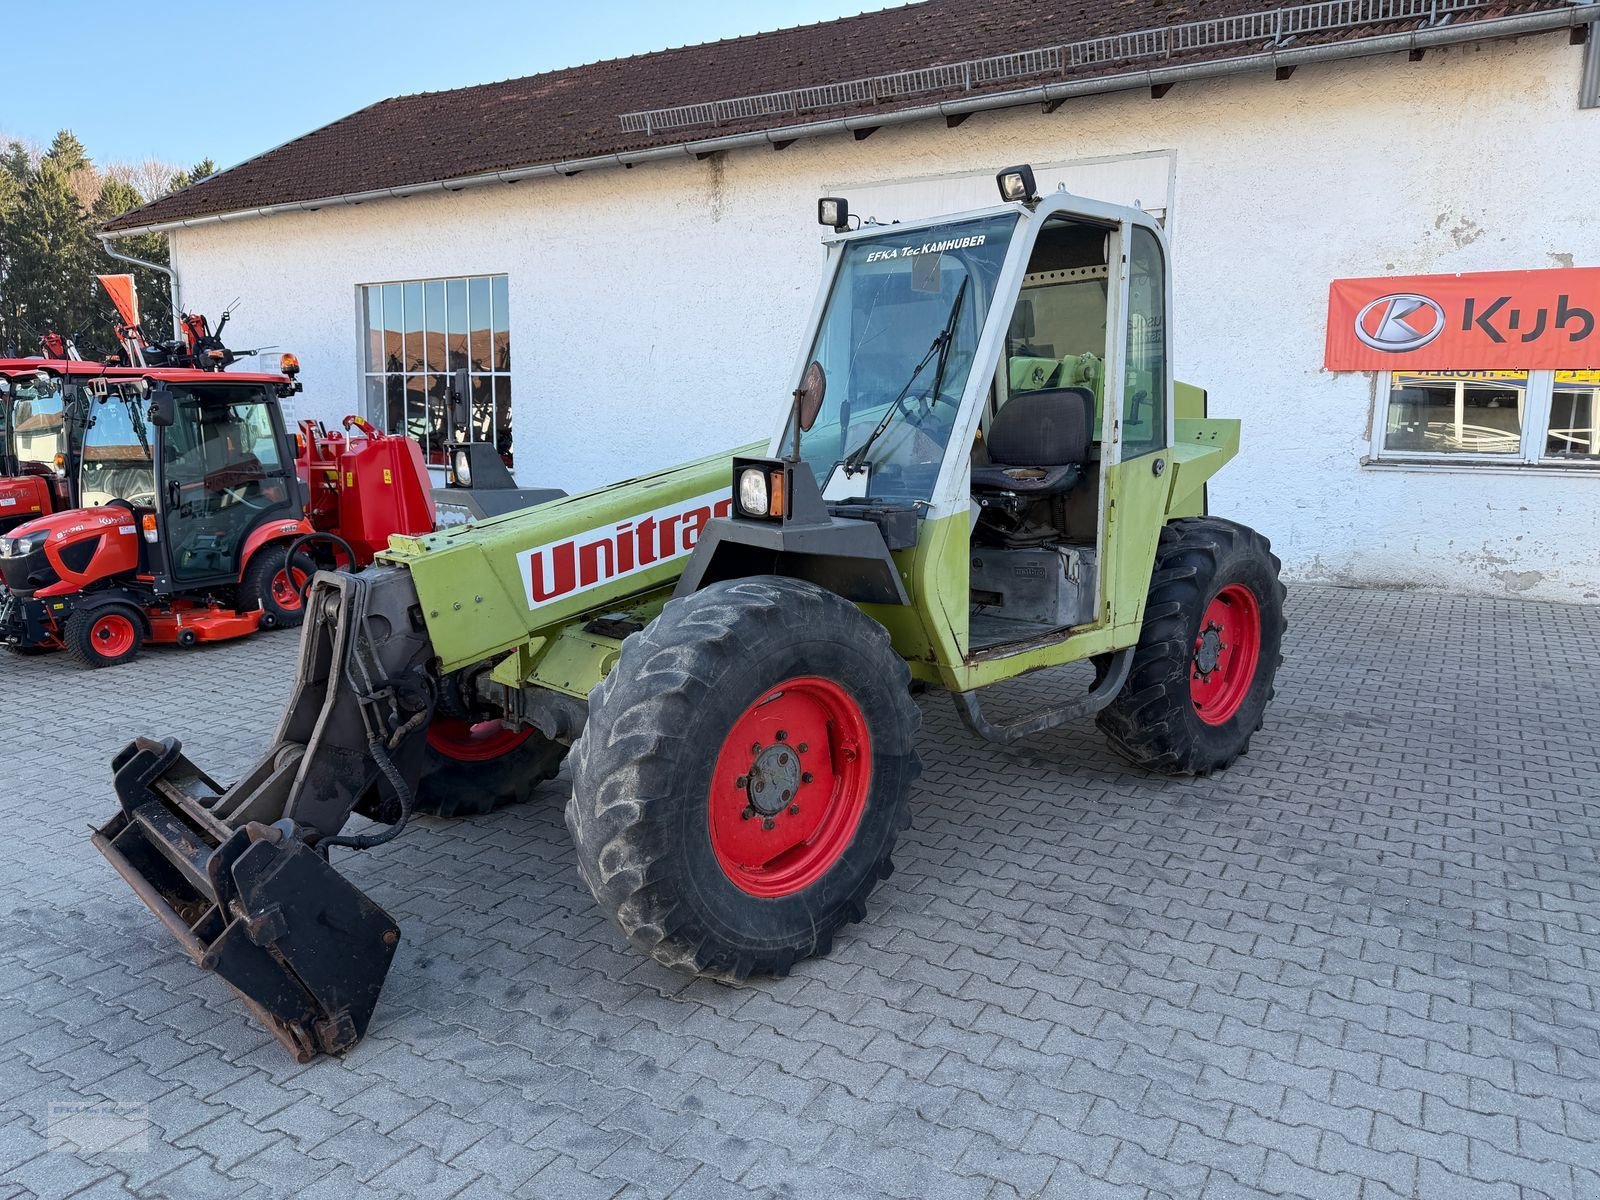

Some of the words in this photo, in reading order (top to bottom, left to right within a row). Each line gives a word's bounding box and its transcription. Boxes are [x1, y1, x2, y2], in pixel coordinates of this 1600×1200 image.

[866, 249, 898, 262] EFKA
[902, 246, 921, 257] Tec
[921, 235, 986, 254] KAMHUBER
[1462, 295, 1594, 343] Kub
[531, 497, 732, 602] Unitra
